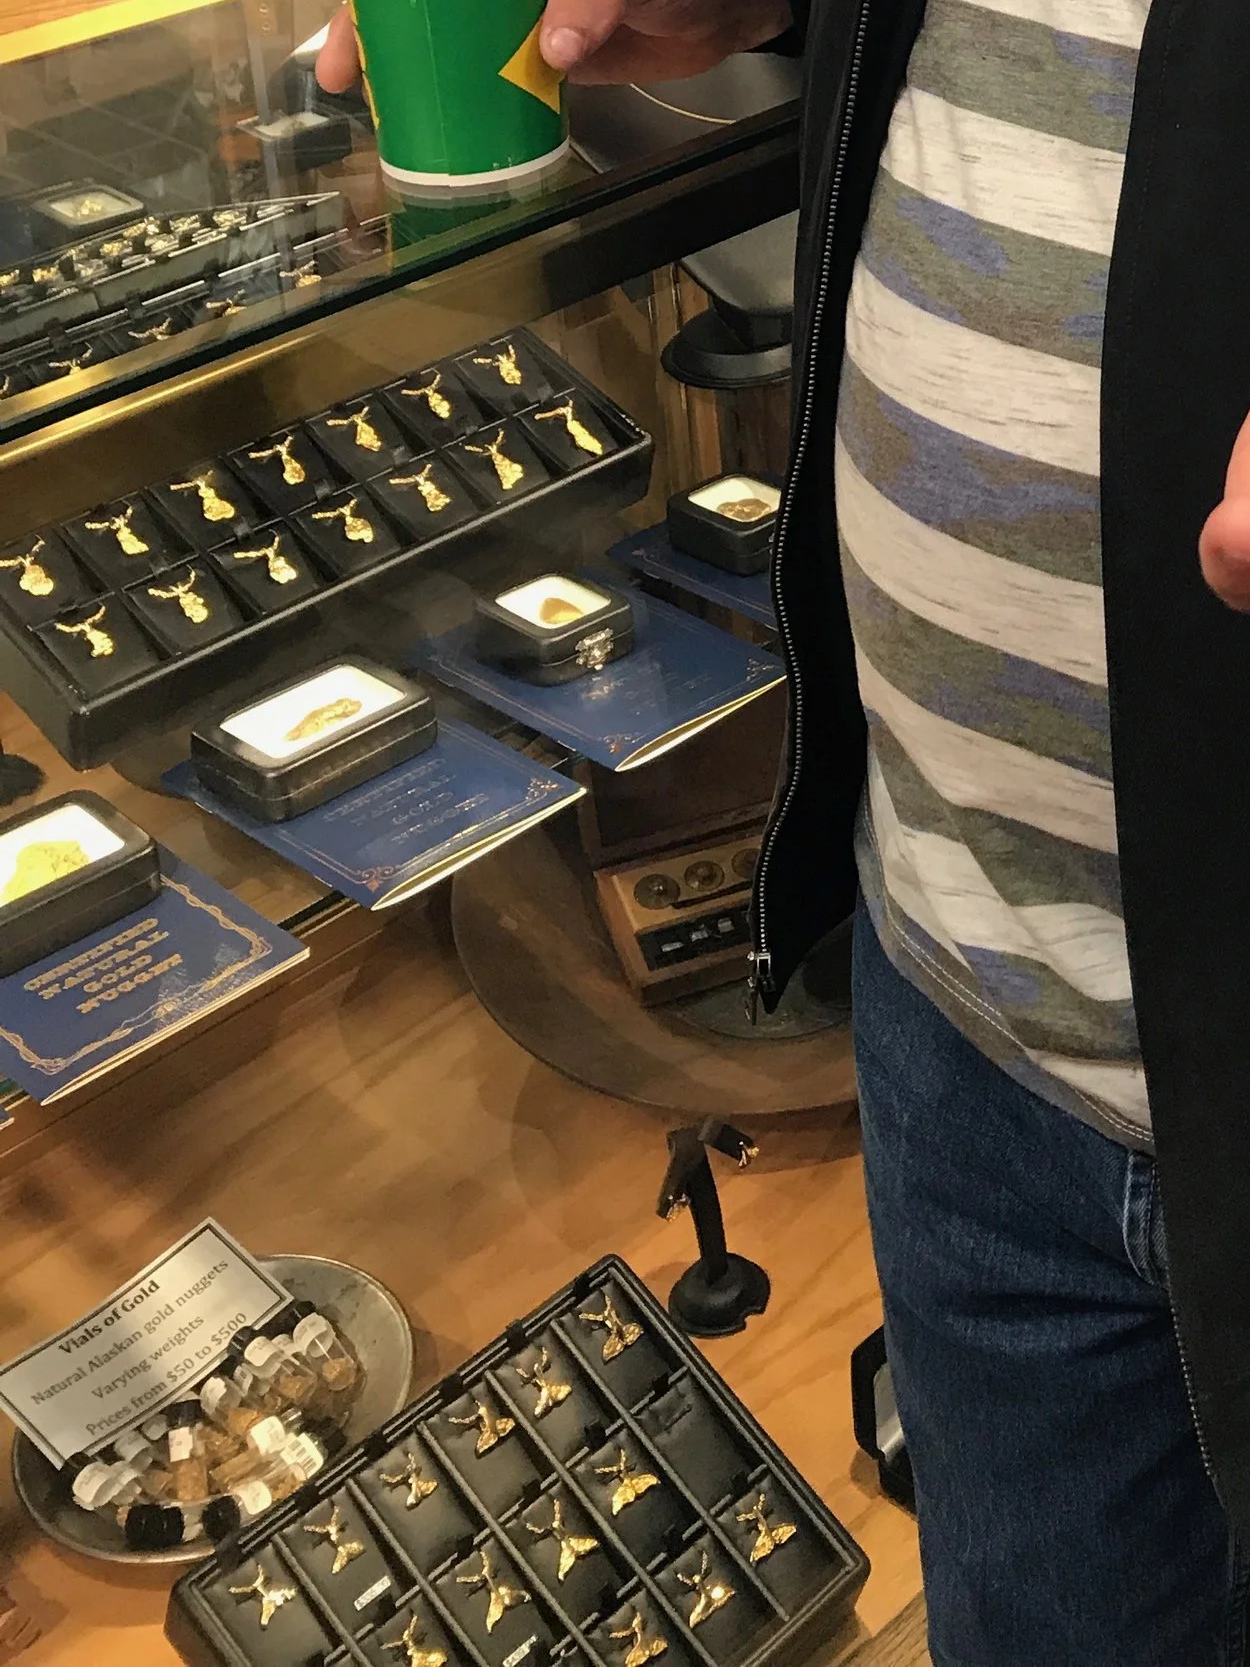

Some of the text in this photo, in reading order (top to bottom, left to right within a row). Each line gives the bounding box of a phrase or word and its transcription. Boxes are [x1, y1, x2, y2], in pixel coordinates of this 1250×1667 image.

[38, 931, 170, 1000] NATURAL
[83, 954, 153, 993] GOLD
[30, 1259, 229, 1406] Natural Alaskan gold nuggets
[58, 1279, 161, 1355] Vials of Gold
[85, 1406, 133, 1437] Prices
[130, 1379, 169, 1412] from
[166, 1356, 196, 1385] $50
[194, 1344, 213, 1365] to
[210, 1311, 248, 1347] $500
[91, 1358, 152, 1400] Varying
[149, 1315, 204, 1363] weights
